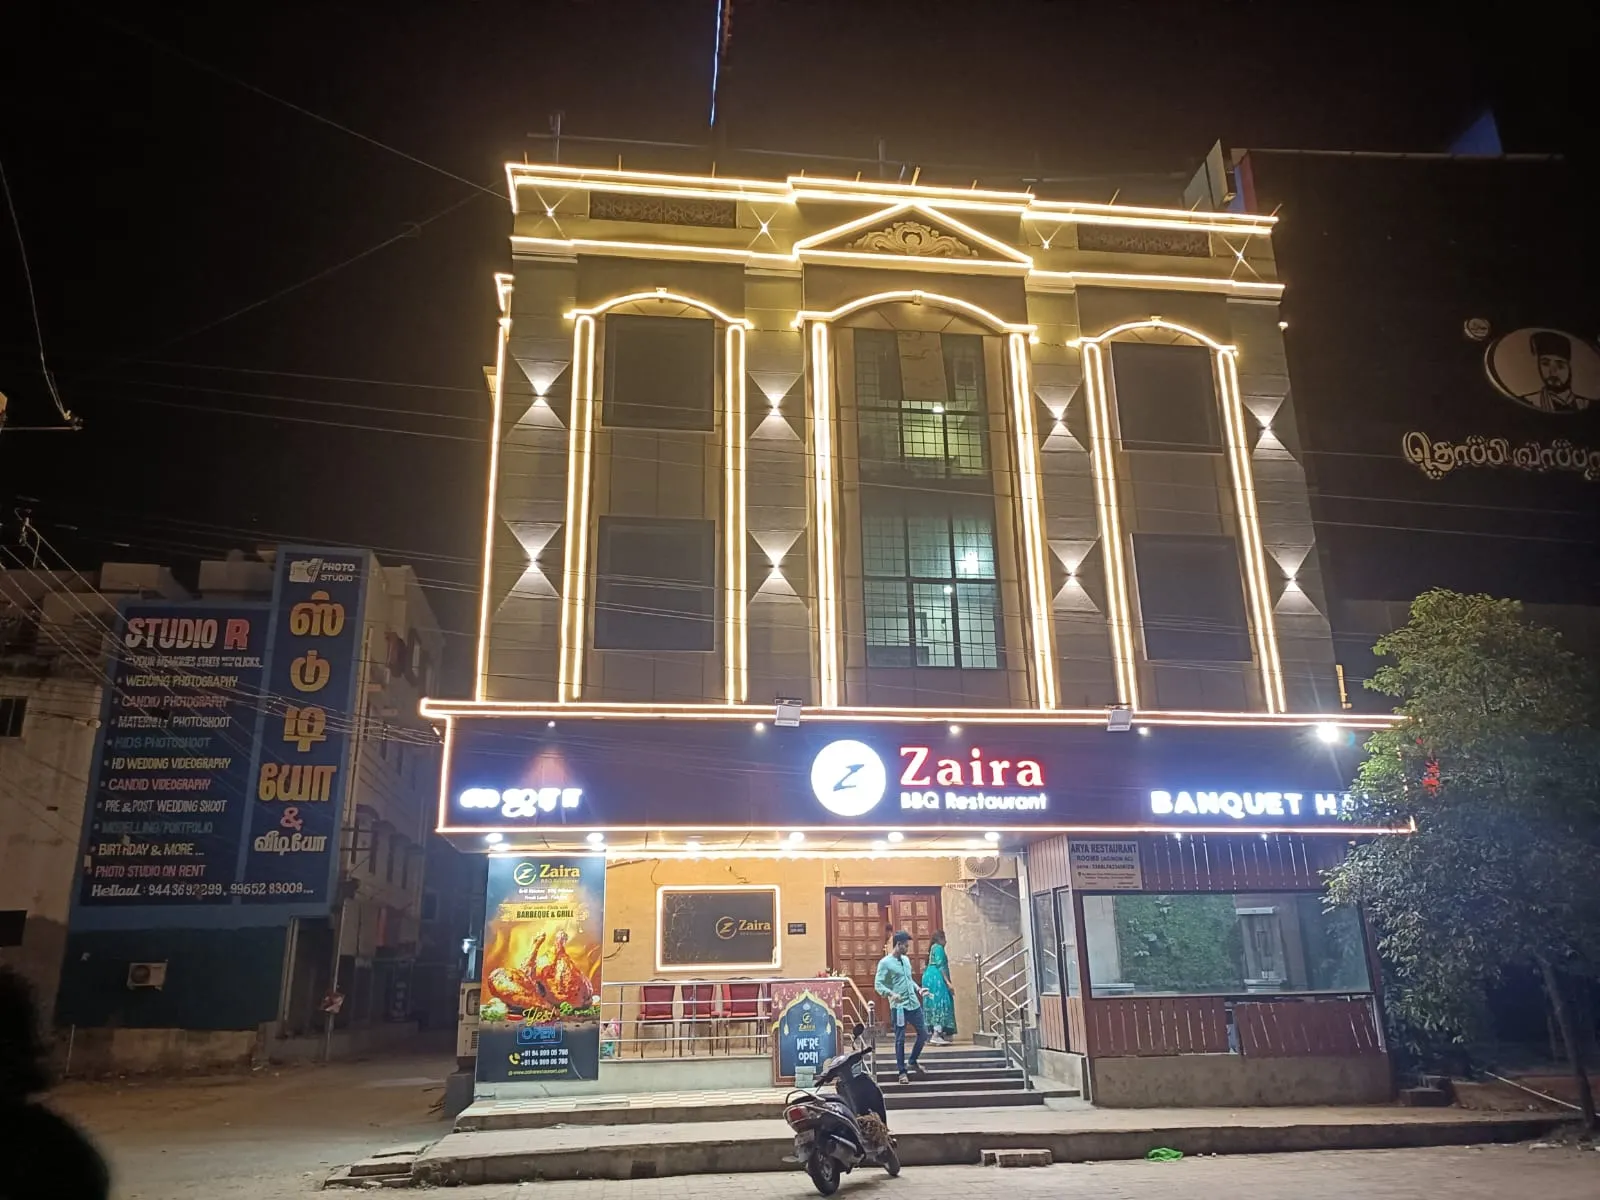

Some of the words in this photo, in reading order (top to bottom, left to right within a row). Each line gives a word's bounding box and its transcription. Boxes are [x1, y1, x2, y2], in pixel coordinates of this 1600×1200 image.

[322, 563, 355, 572] PHOTO
[125, 617, 218, 649] STUDIO
[224, 618, 250, 650] R
[126, 675, 170, 687] WEDDING
[172, 675, 238, 688] PHOTOGRAPHY
[121, 695, 161, 708] CANDID
[163, 695, 228, 709] PHOTOGRAPHY
[172, 716, 232, 728] PHOTOSHOOT
[145, 736, 211, 748] PHOTOSHOOT
[112, 758, 125, 769] HD
[126, 757, 169, 769] WEDDING
[171, 757, 231, 770] VIDEOGRAPHY
[900, 746, 1045, 787] Zaira
[108, 778, 149, 790] CANDID
[152, 778, 212, 790] VIDEOGRAPHY
[105, 800, 121, 811] PRE
[156, 800, 197, 812] WEDDING
[199, 800, 227, 812] SHOOT
[901, 791, 940, 809] BBQ
[945, 791, 1048, 810] Restaurant
[1150, 790, 1303, 819] BANQUET
[279, 807, 303, 831] &
[150, 844, 162, 856] &
[1071, 843, 1090, 854] ARYA
[1091, 843, 1137, 854] RESTAURANT
[95, 864, 125, 877] PHOTO
[127, 865, 161, 877] STUDIO
[162, 865, 177, 877] ON
[179, 864, 208, 877] RENT
[540, 864, 581, 878] Zaira
[516, 910, 550, 919] BARBEQUE
[556, 910, 574, 918] GRILL
[738, 919, 771, 931] Zaira
[521, 1026, 556, 1040] OPEN
[796, 1037, 820, 1050] WE'RE
[797, 1052, 819, 1064] OPEN
